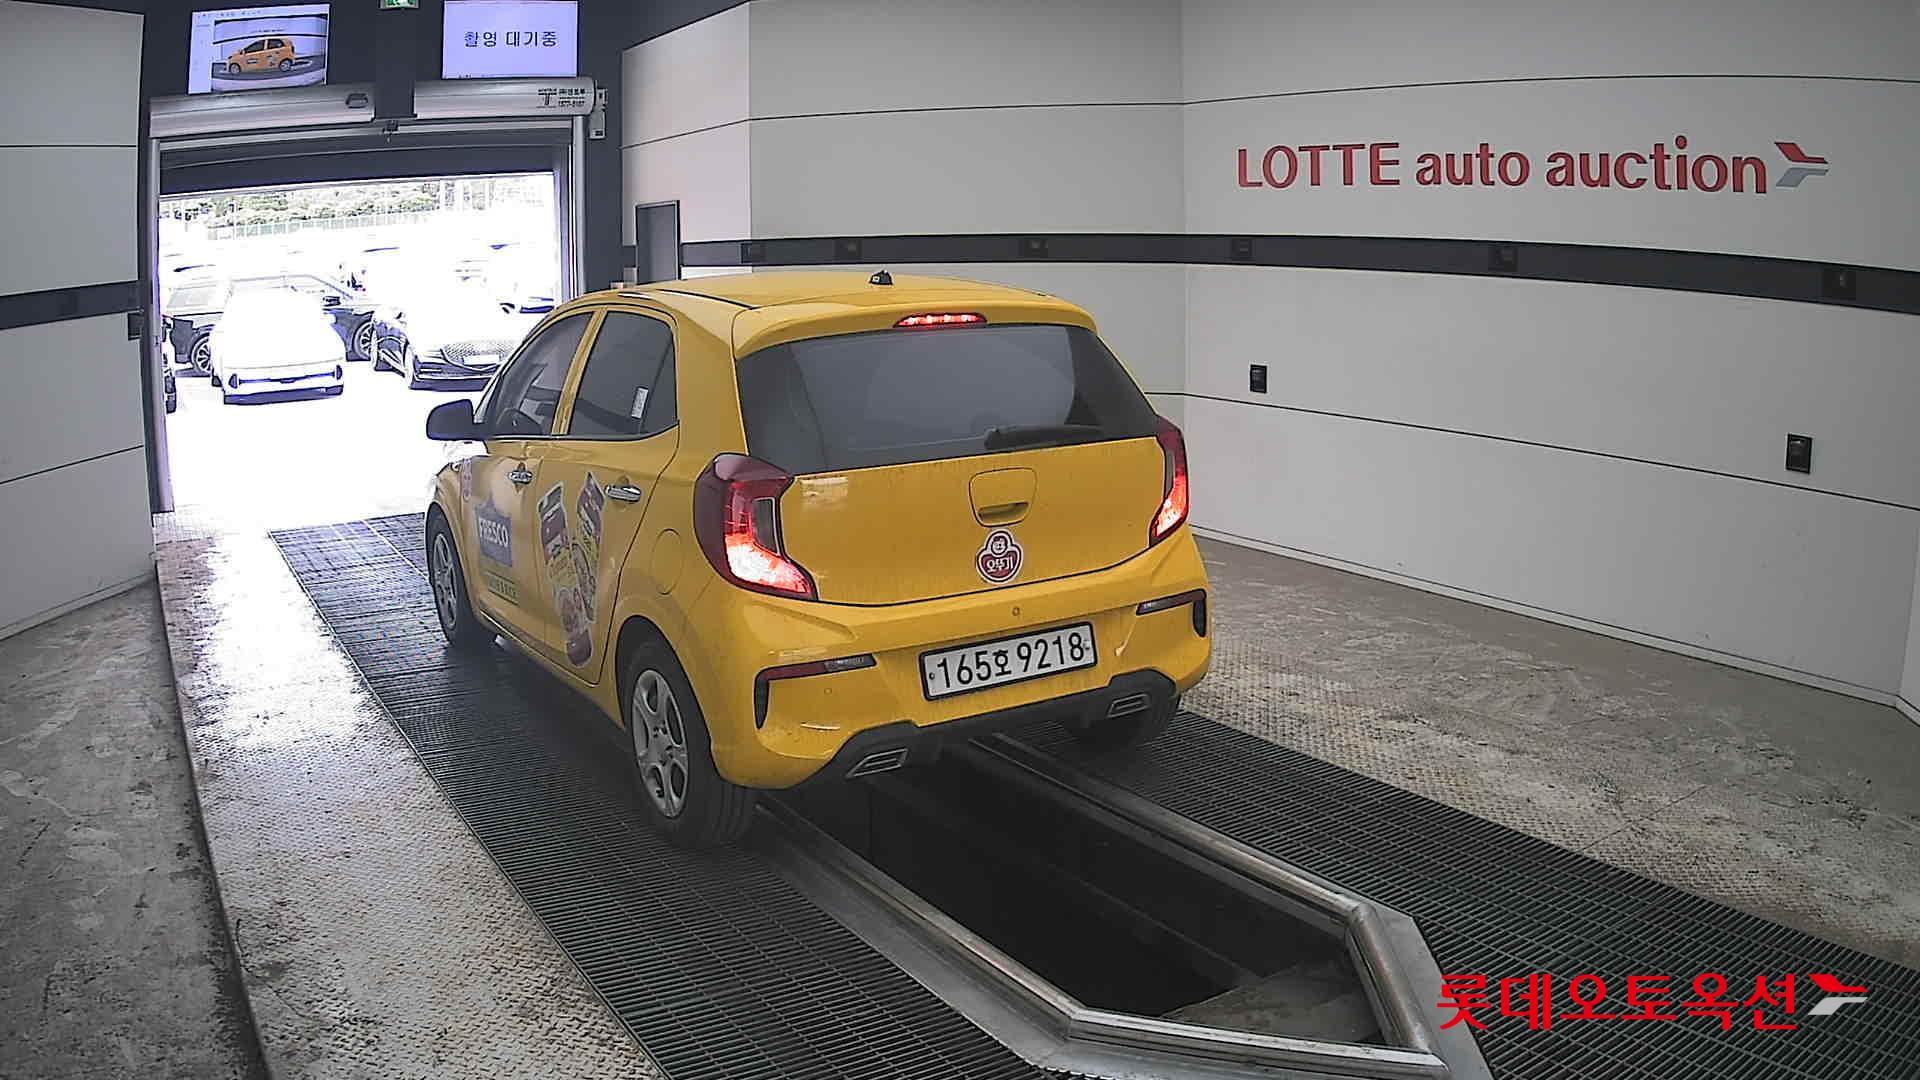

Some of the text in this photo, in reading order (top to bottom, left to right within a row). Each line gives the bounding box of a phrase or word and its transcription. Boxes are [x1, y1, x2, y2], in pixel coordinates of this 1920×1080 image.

[506, 31, 557, 48] 대기중
[1237, 135, 1768, 193] LOTTE auto auction
[986, 557, 1014, 573] 오뚜기
[937, 632, 1084, 688] 165호 9218
